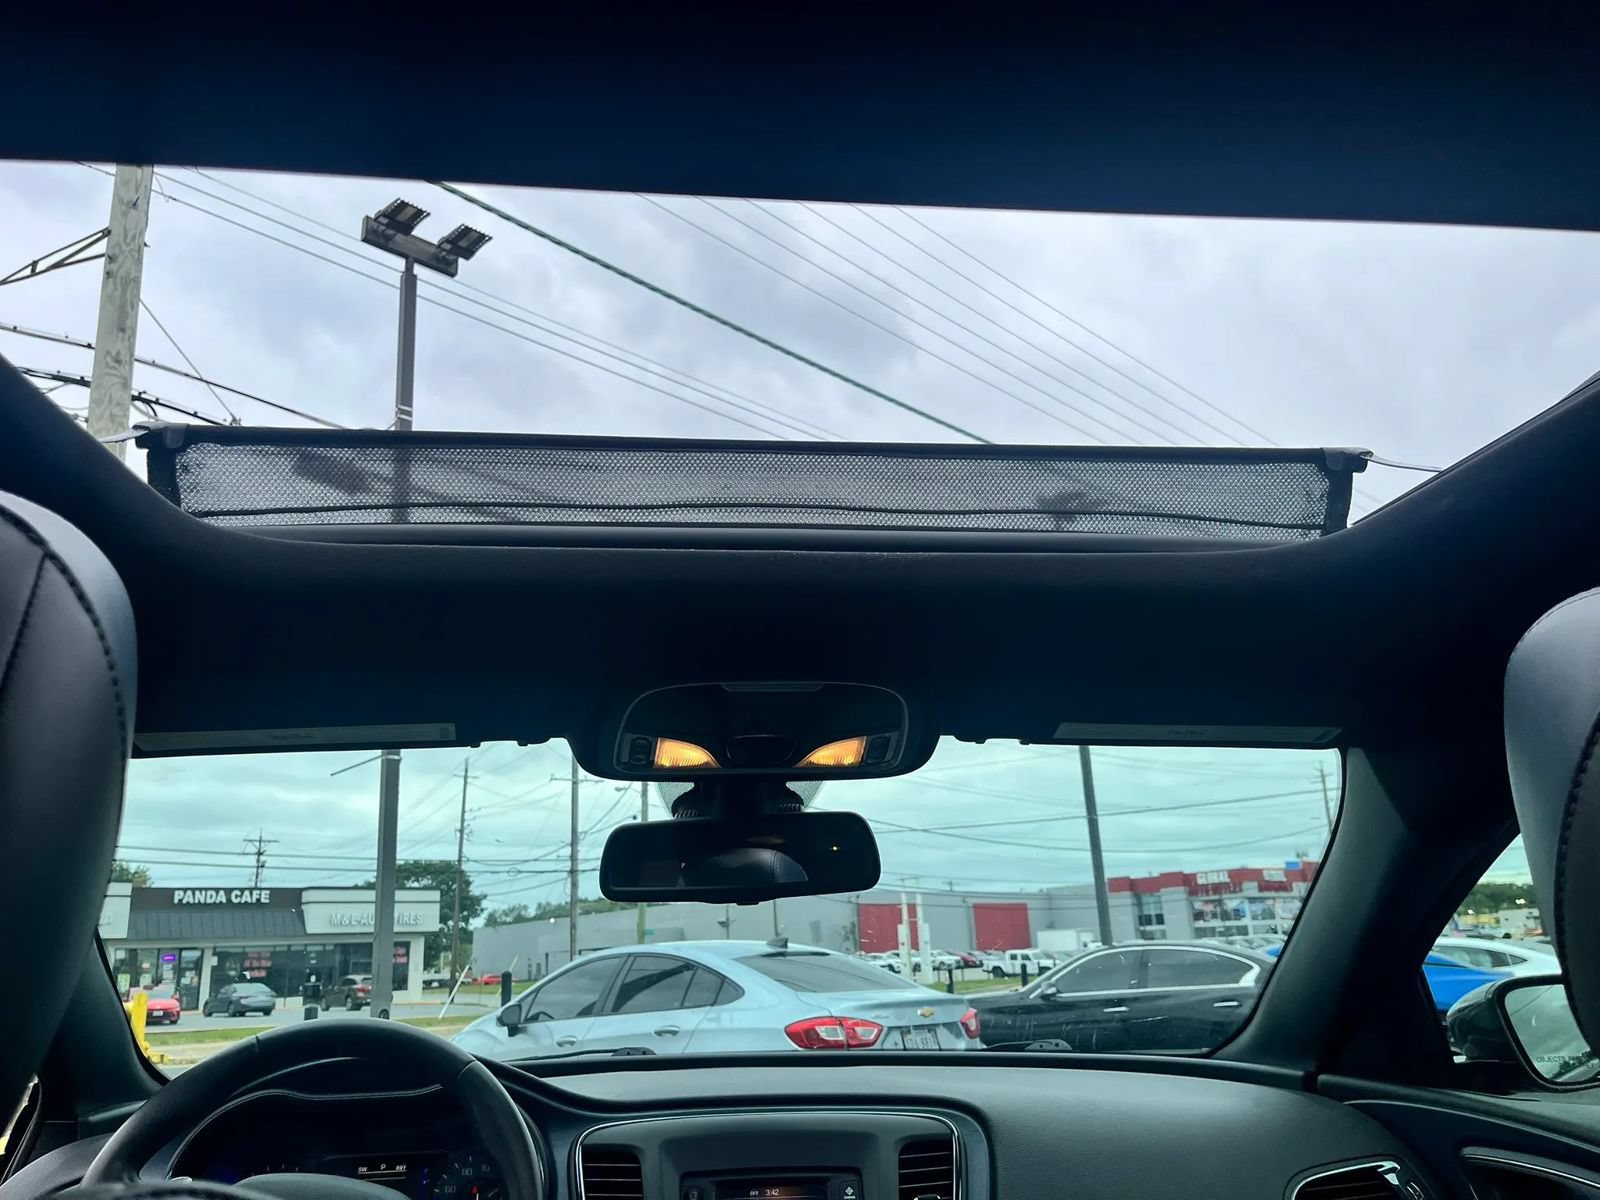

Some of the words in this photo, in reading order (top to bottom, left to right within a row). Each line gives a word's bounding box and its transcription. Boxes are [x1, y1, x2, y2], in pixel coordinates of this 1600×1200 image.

[173, 889, 227, 904] PANDA
[230, 889, 271, 904] CAFE
[380, 1163, 387, 1171] P
